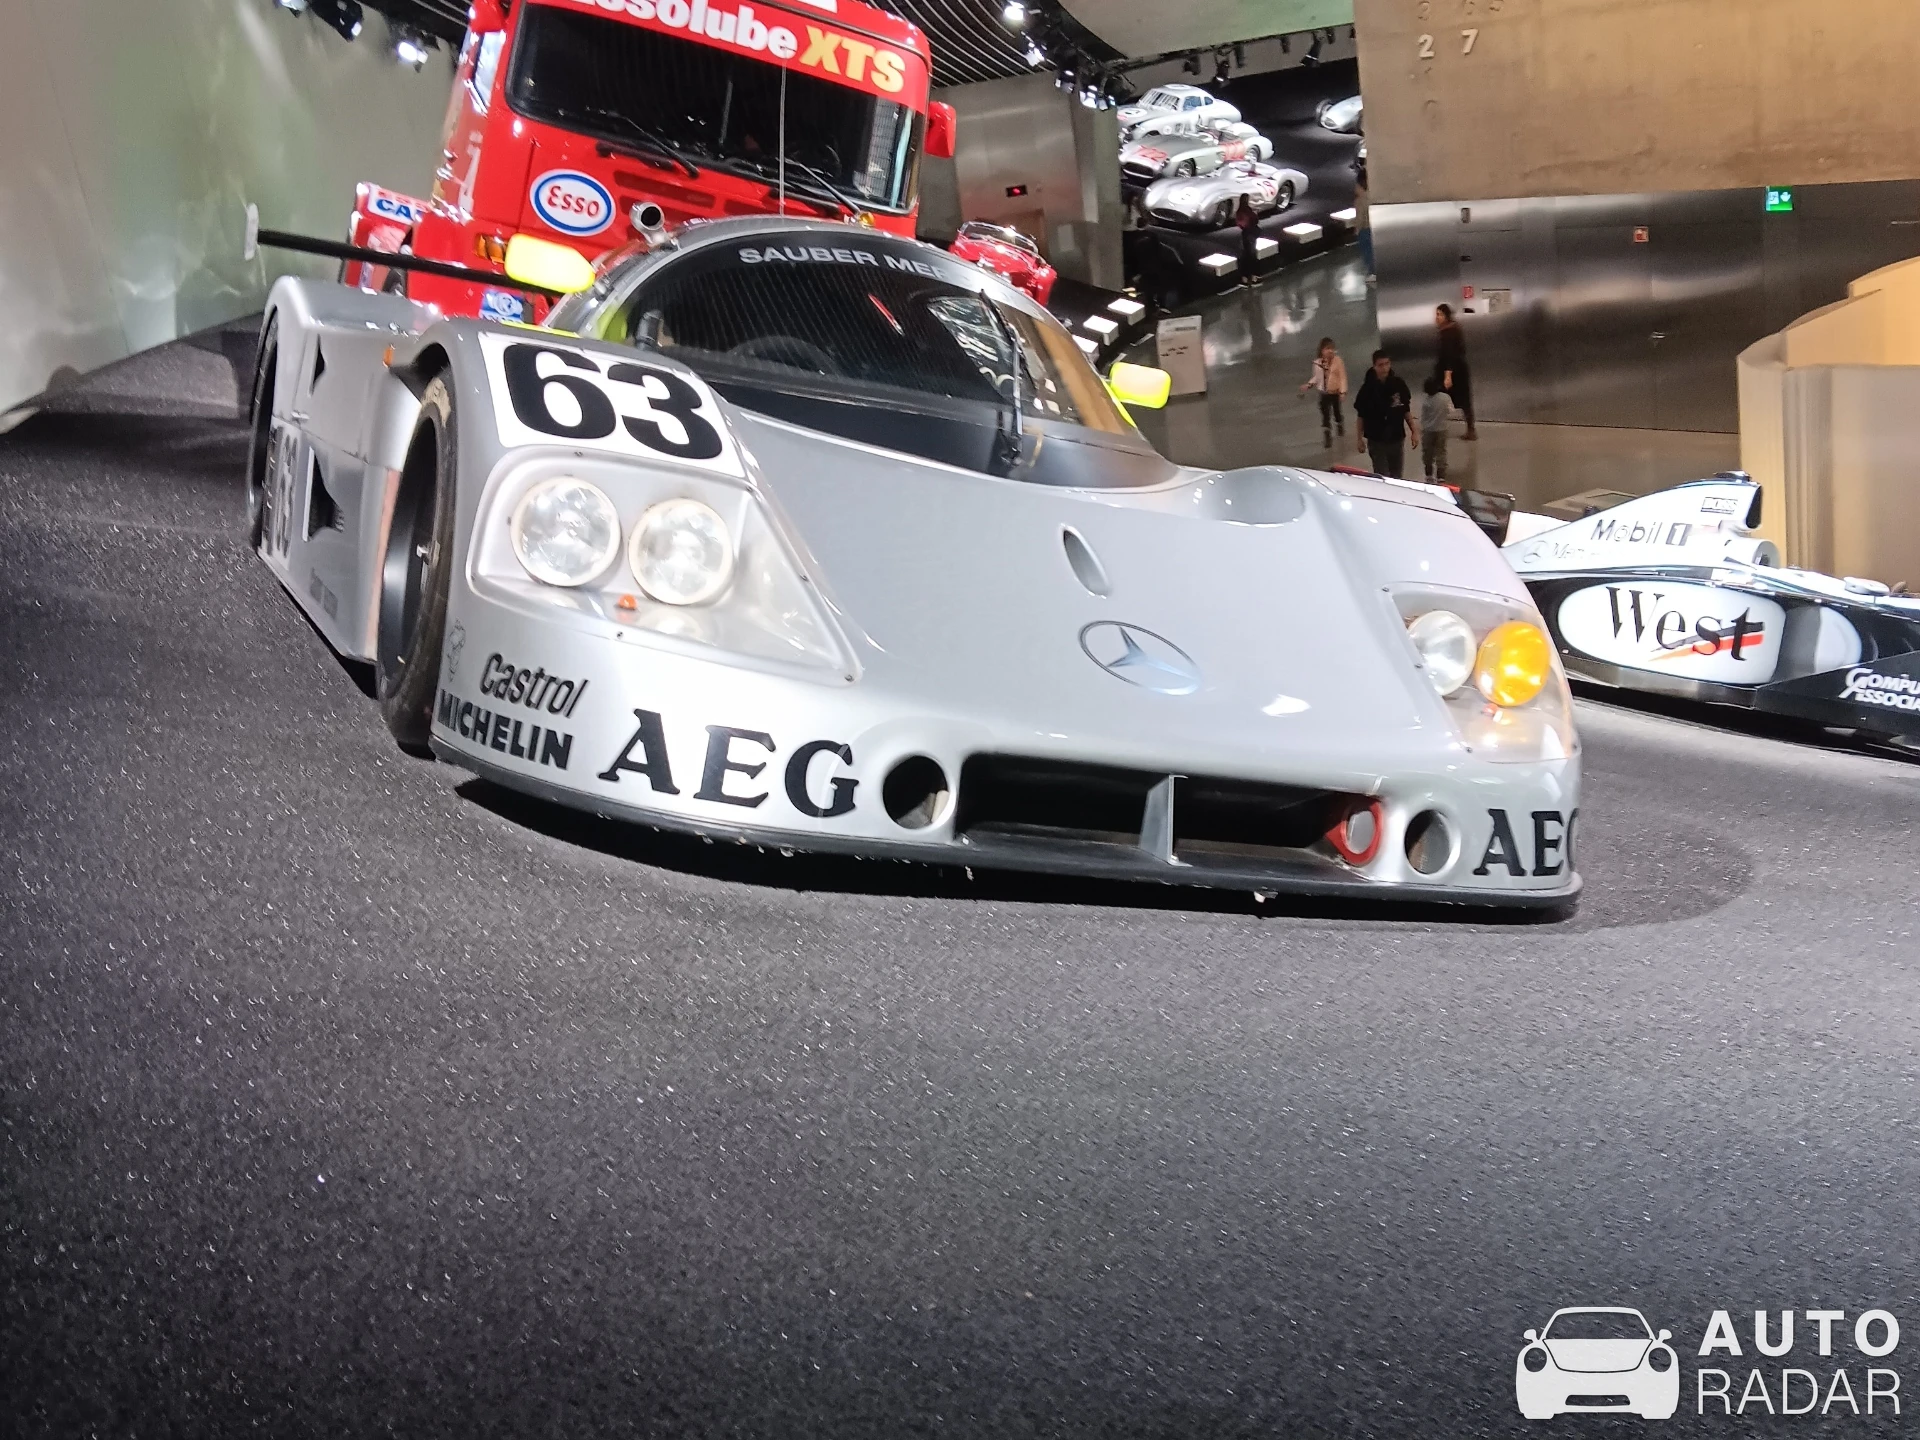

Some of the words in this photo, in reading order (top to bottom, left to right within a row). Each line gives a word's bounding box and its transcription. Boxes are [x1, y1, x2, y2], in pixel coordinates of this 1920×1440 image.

[571, 0, 798, 60] solube
[799, 25, 906, 94] XTS
[376, 199, 422, 222] CA
[739, 247, 880, 266] SAUBER
[503, 342, 723, 460] 63
[1590, 518, 1664, 545] Mobil
[1667, 522, 1693, 547] 1
[1607, 586, 1764, 662] West
[479, 653, 590, 719] Castrol
[437, 688, 574, 771] MICHELIN
[598, 708, 860, 819] AEG
